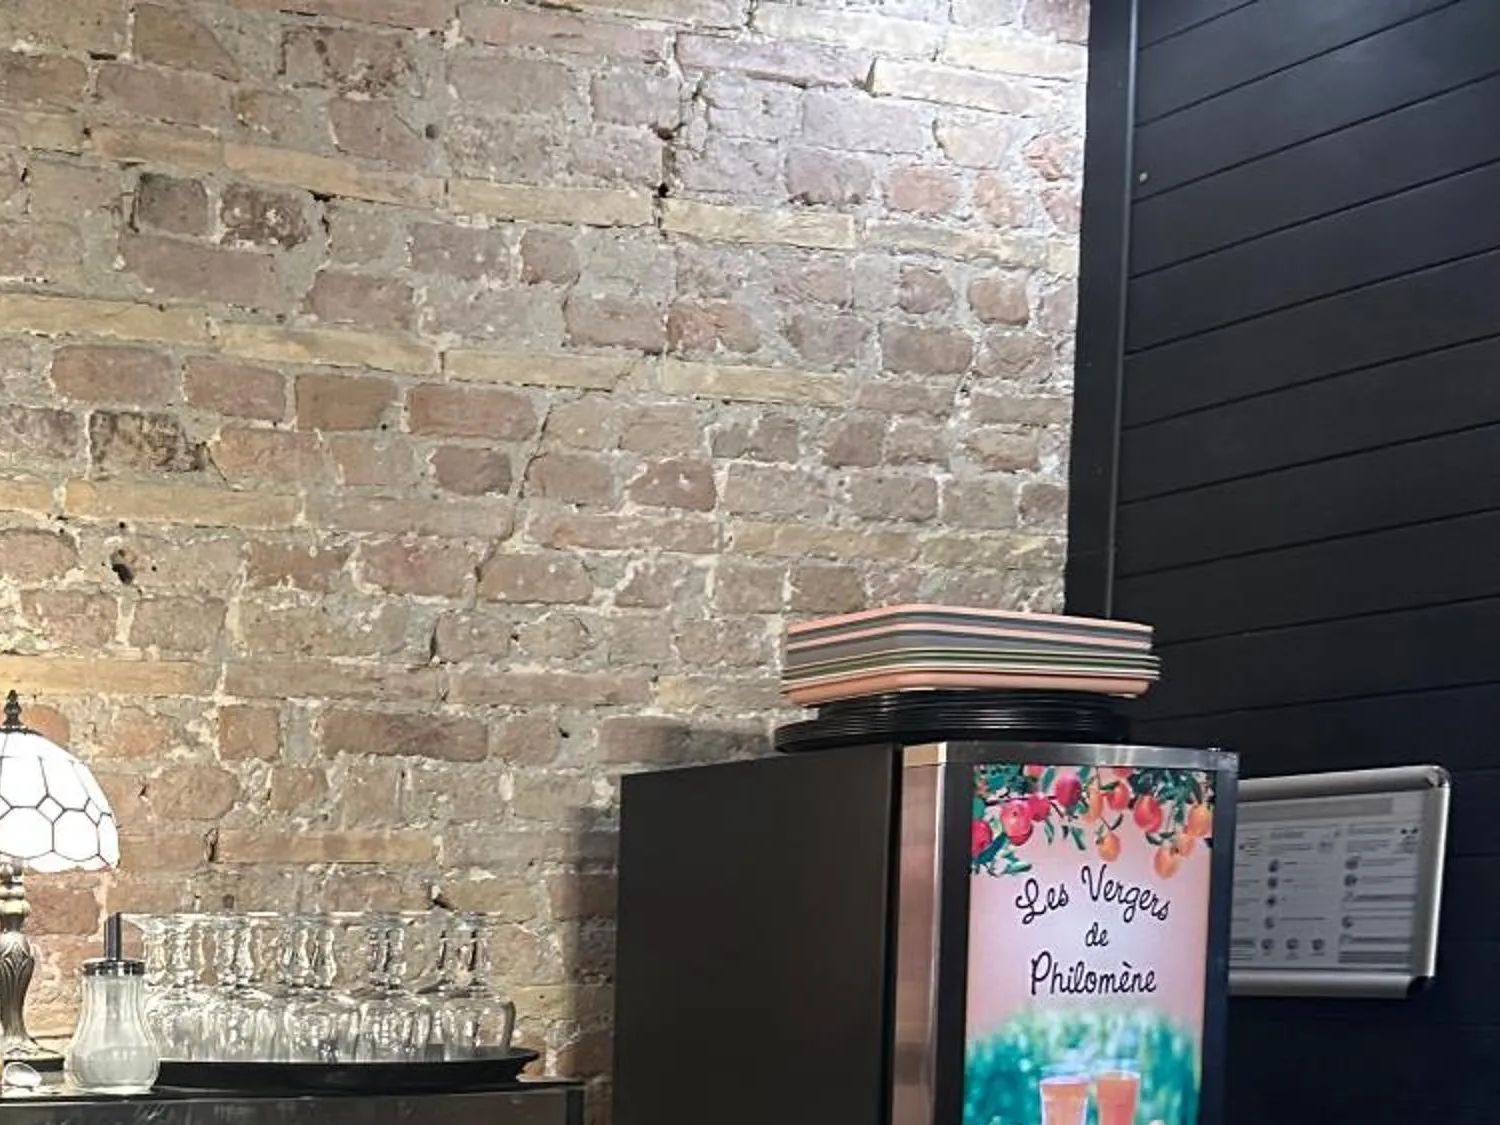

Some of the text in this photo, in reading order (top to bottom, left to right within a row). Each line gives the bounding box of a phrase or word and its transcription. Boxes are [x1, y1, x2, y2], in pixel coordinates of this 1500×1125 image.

[1015, 863, 1171, 925] Les Vergers
[1084, 921, 1110, 947] de
[1030, 951, 1157, 996] Philomène
